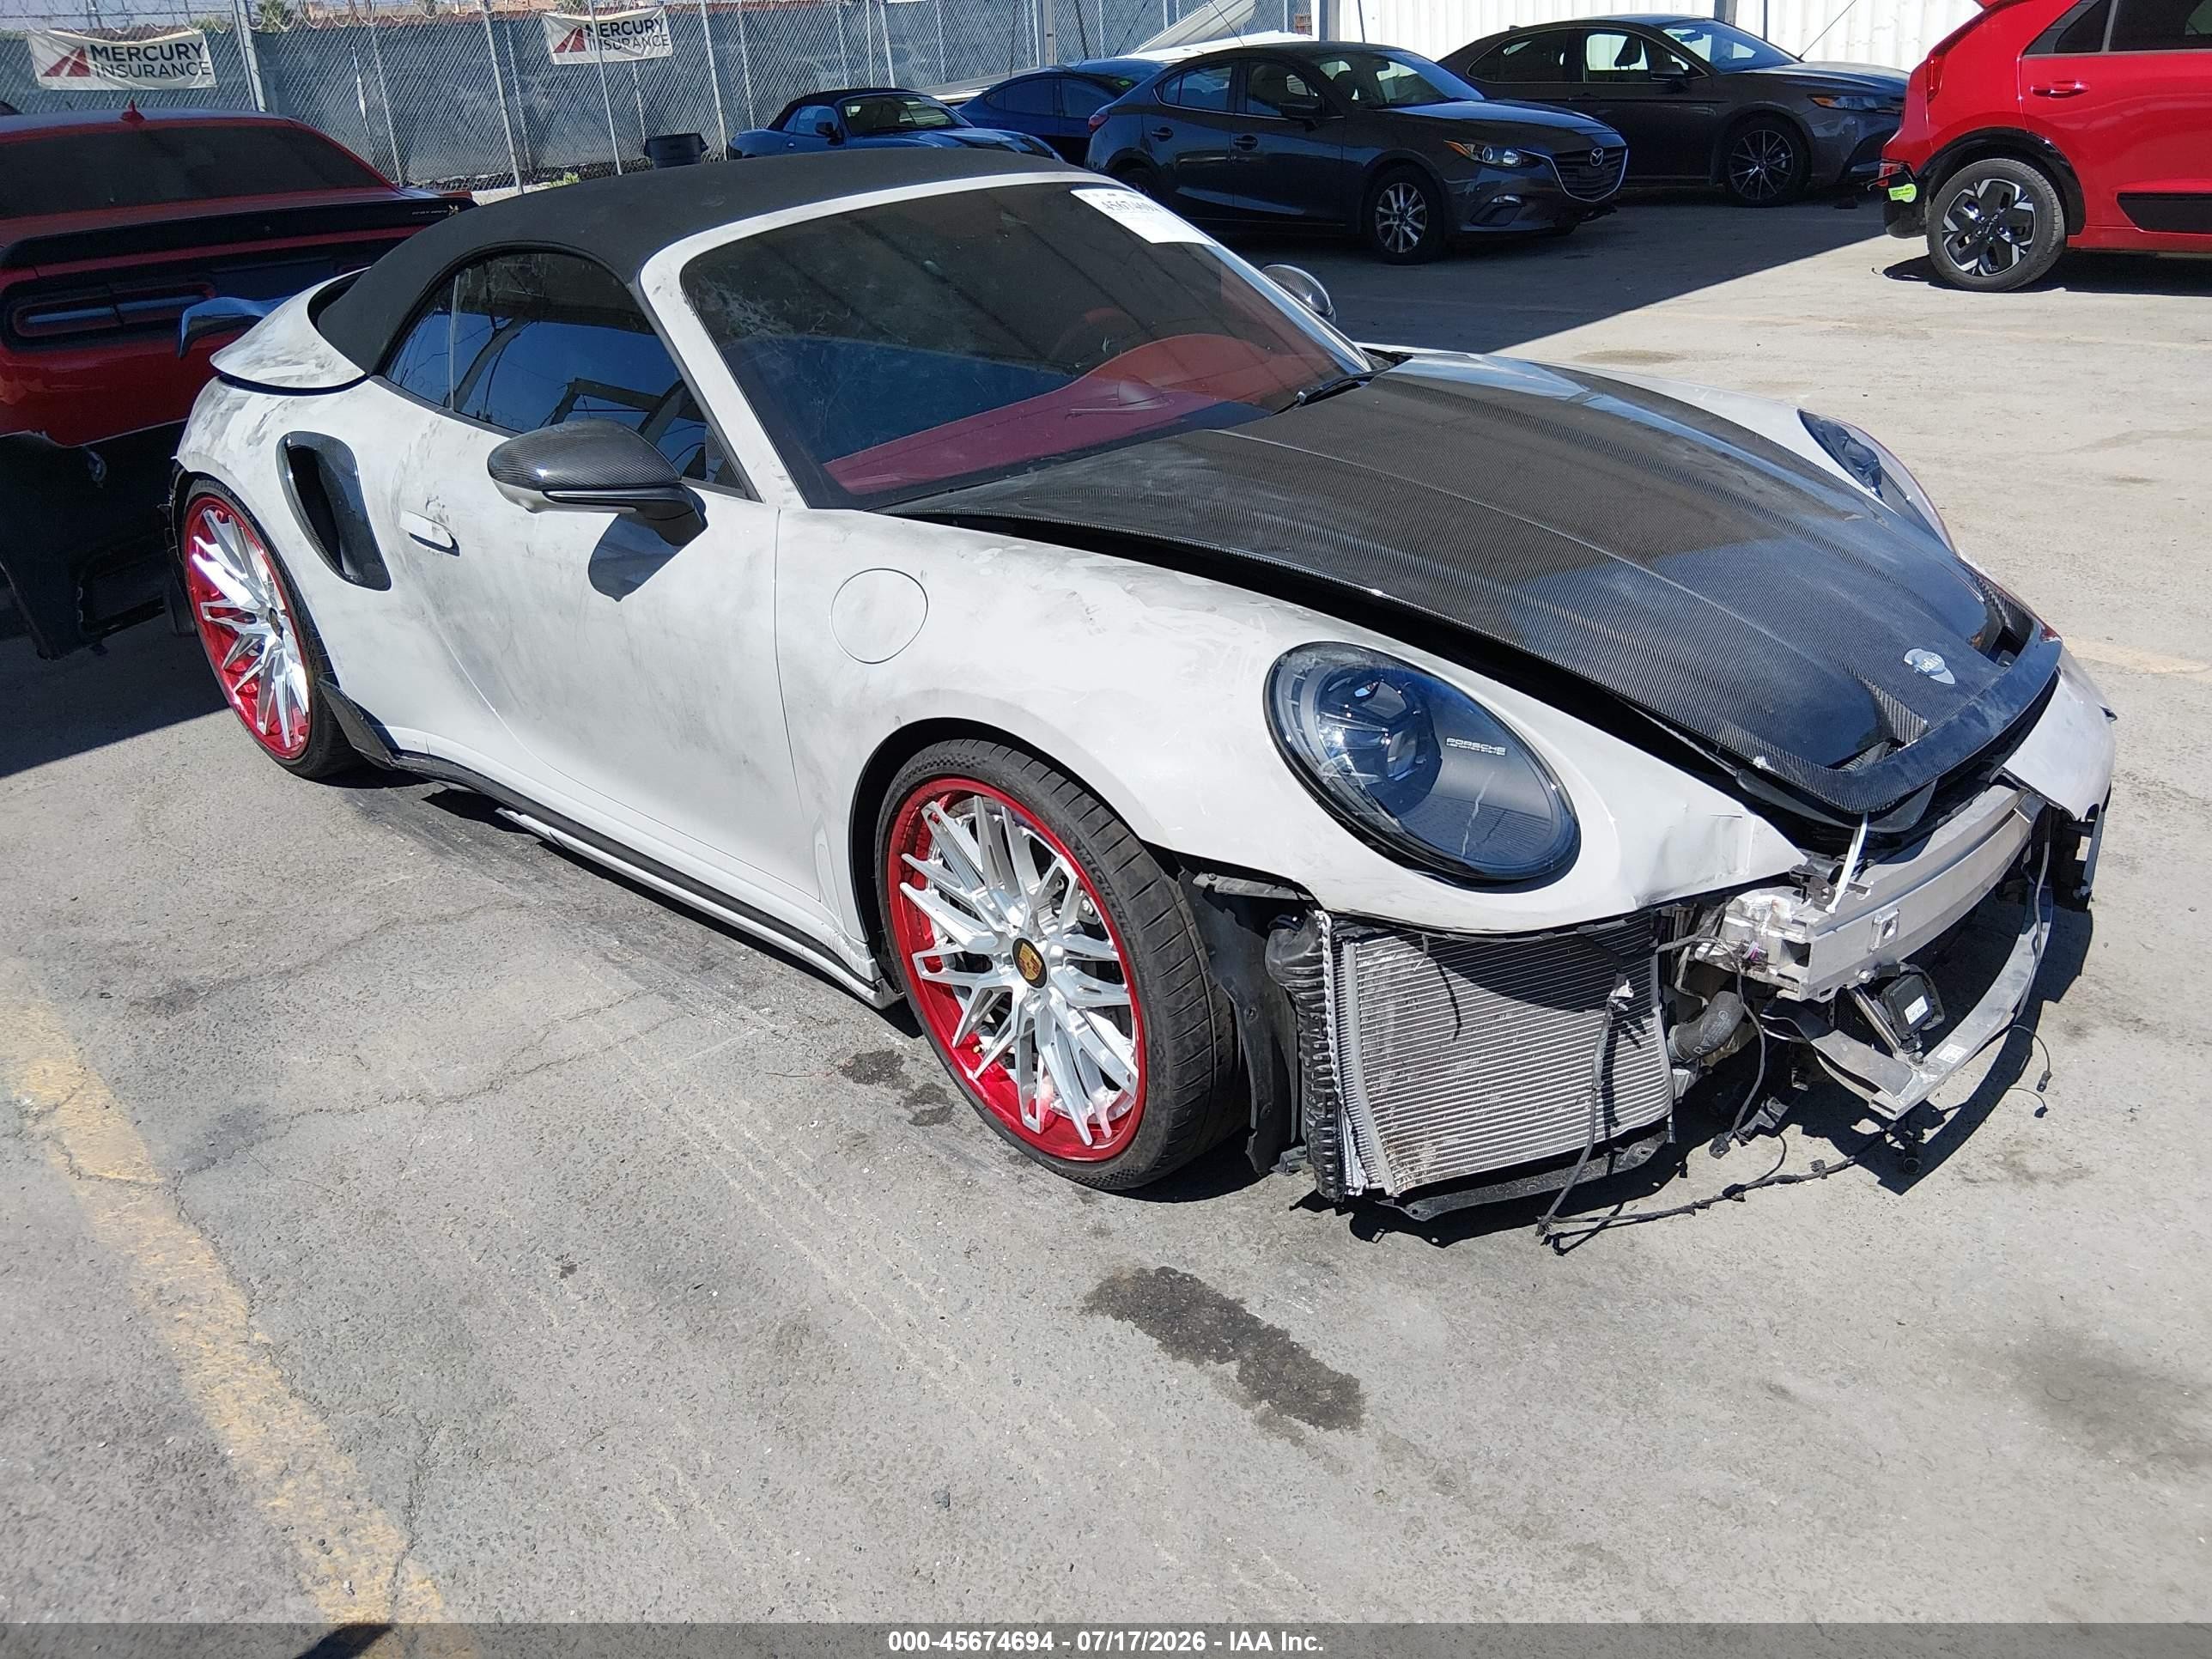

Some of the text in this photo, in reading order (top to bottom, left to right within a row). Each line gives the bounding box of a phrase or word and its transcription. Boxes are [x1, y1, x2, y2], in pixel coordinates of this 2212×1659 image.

[586, 19, 665, 37] MERCURY
[589, 34, 670, 52] INSURANCE
[90, 43, 204, 62] MERCURY
[96, 61, 211, 78] INSURANCE
[1446, 737, 1506, 753] PORSCHE
